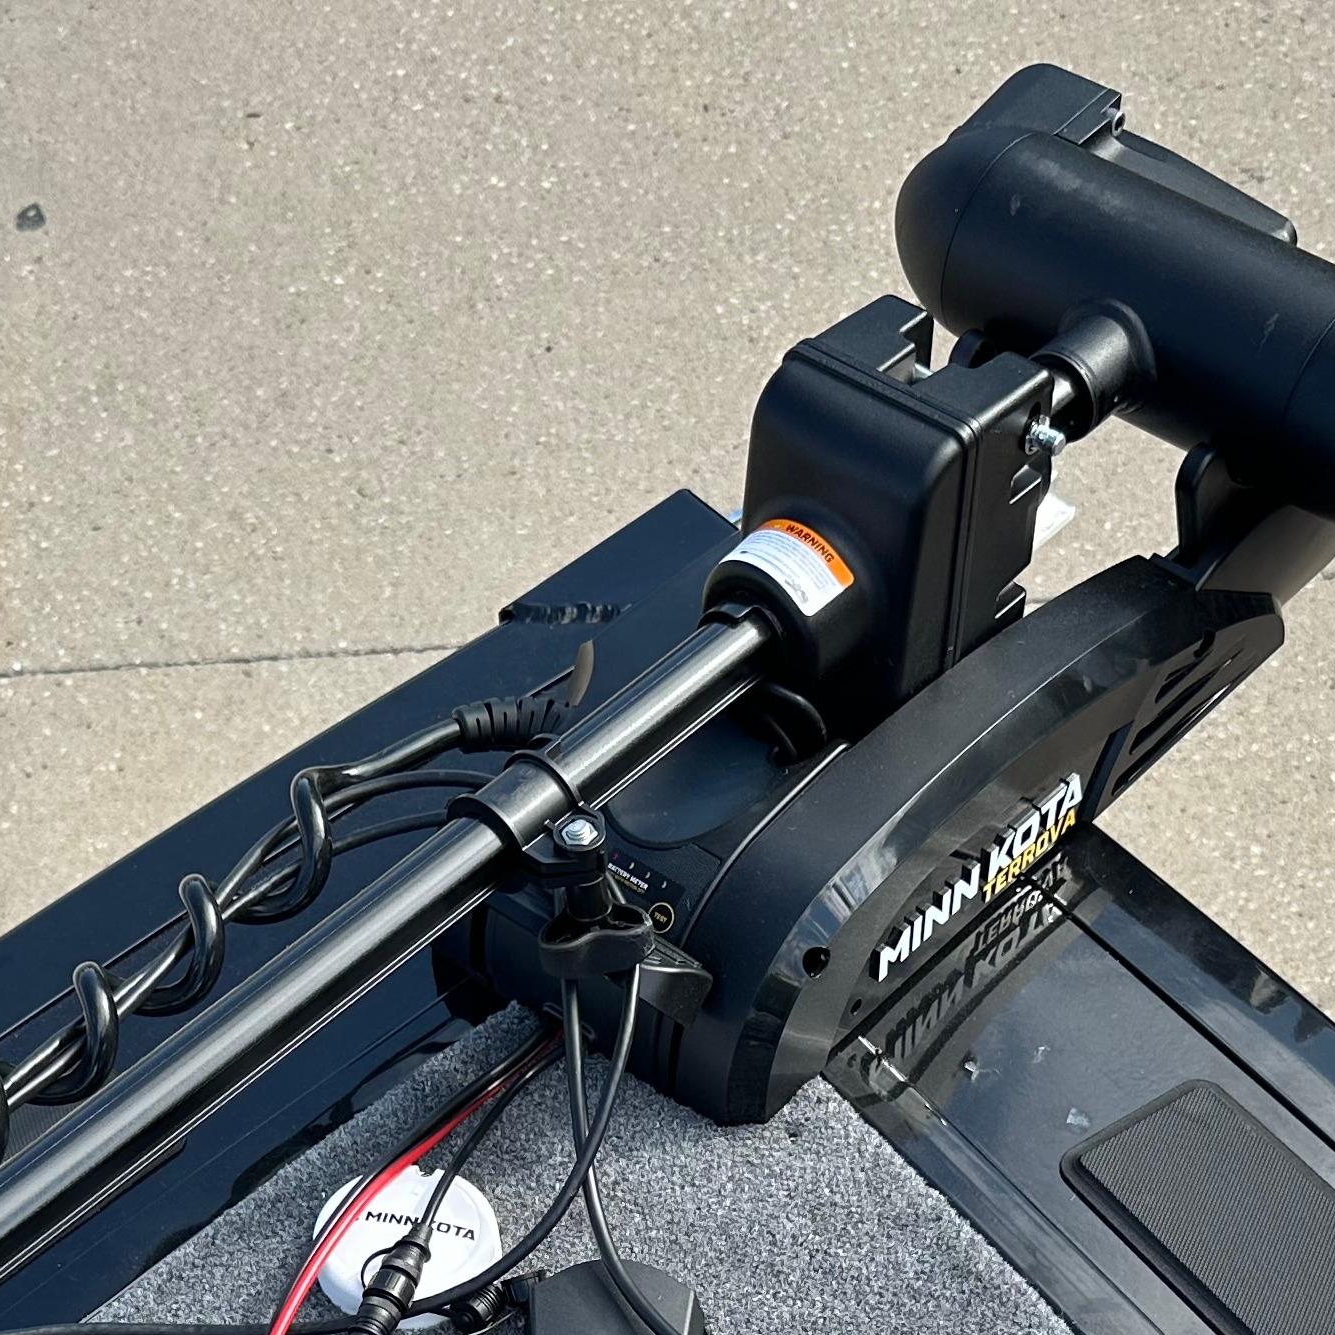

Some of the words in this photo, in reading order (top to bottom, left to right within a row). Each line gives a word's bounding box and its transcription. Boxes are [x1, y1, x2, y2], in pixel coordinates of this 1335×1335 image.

[785, 524, 835, 563] WARNING
[873, 861, 981, 982] MINN
[987, 772, 1083, 882] KOTA
[982, 808, 1077, 903] TERROVA
[365, 1211, 420, 1226] MINN
[430, 1220, 476, 1241] OTA
